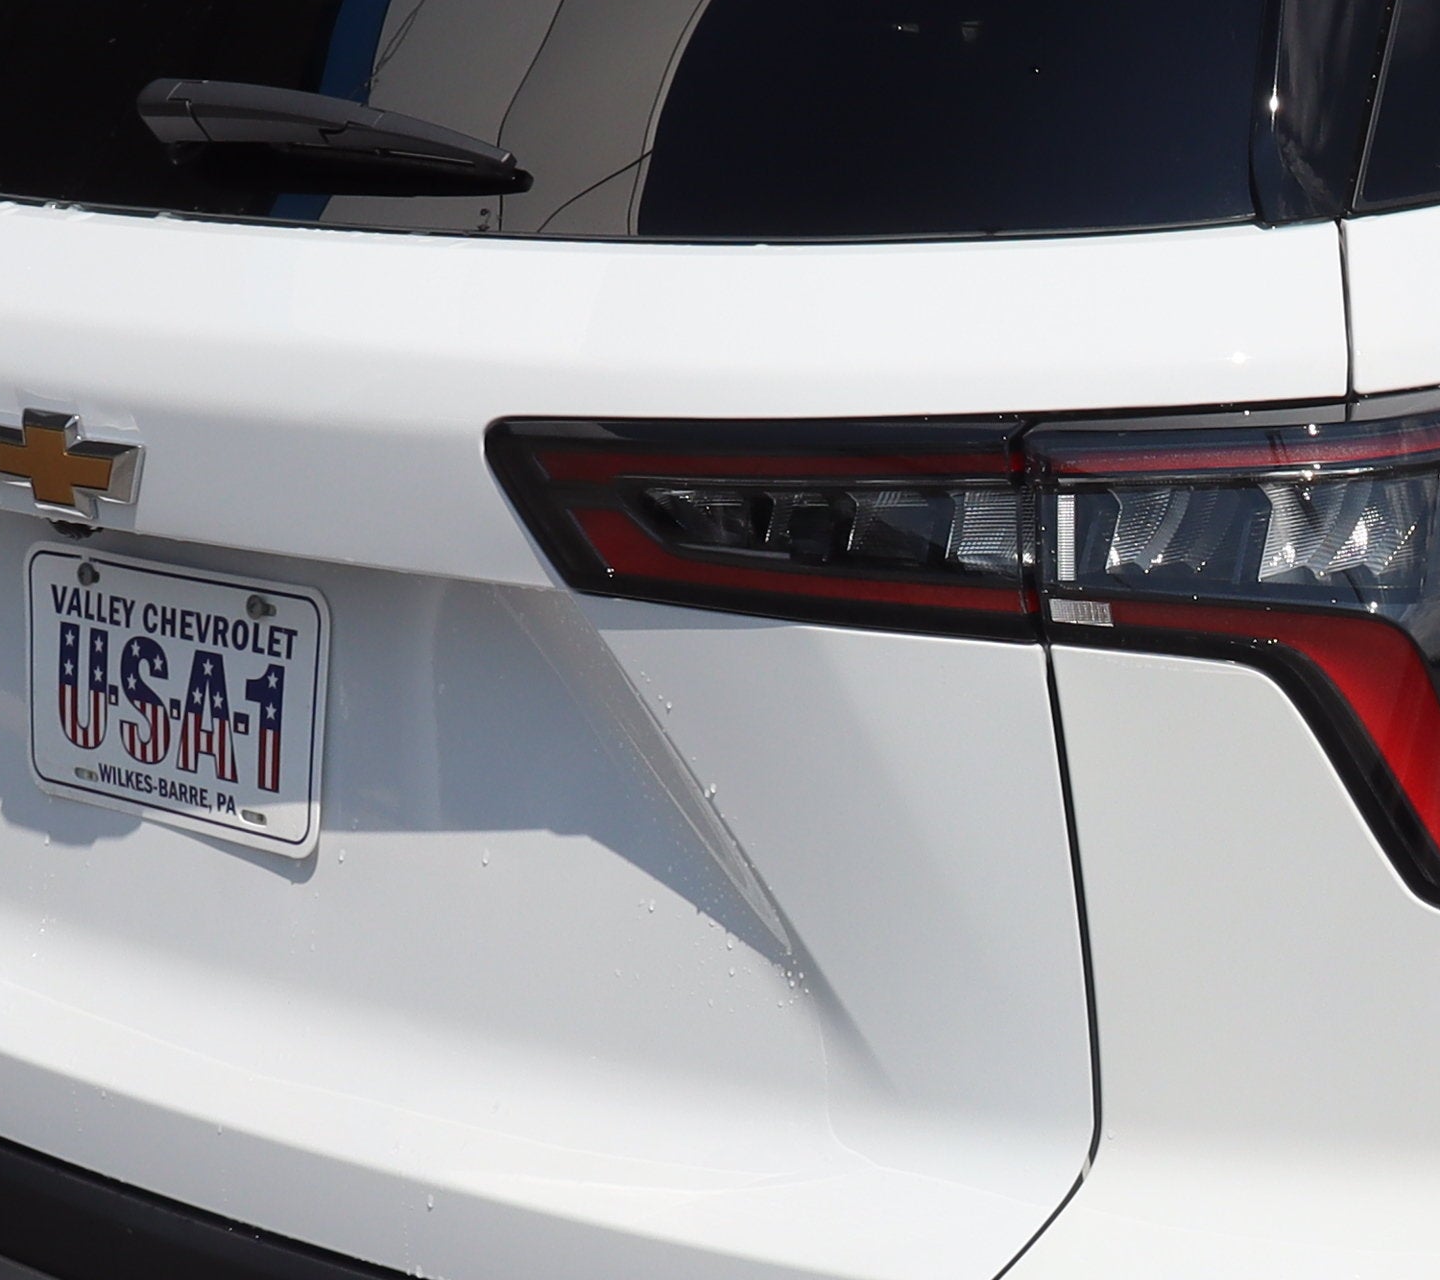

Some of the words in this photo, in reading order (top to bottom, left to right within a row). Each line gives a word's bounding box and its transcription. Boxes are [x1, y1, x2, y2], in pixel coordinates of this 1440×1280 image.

[50, 583, 136, 630] VALLEY
[142, 602, 299, 661] CHEVROLET
[97, 761, 213, 814] WILKES-BARRE,
[217, 792, 237, 817] PA
